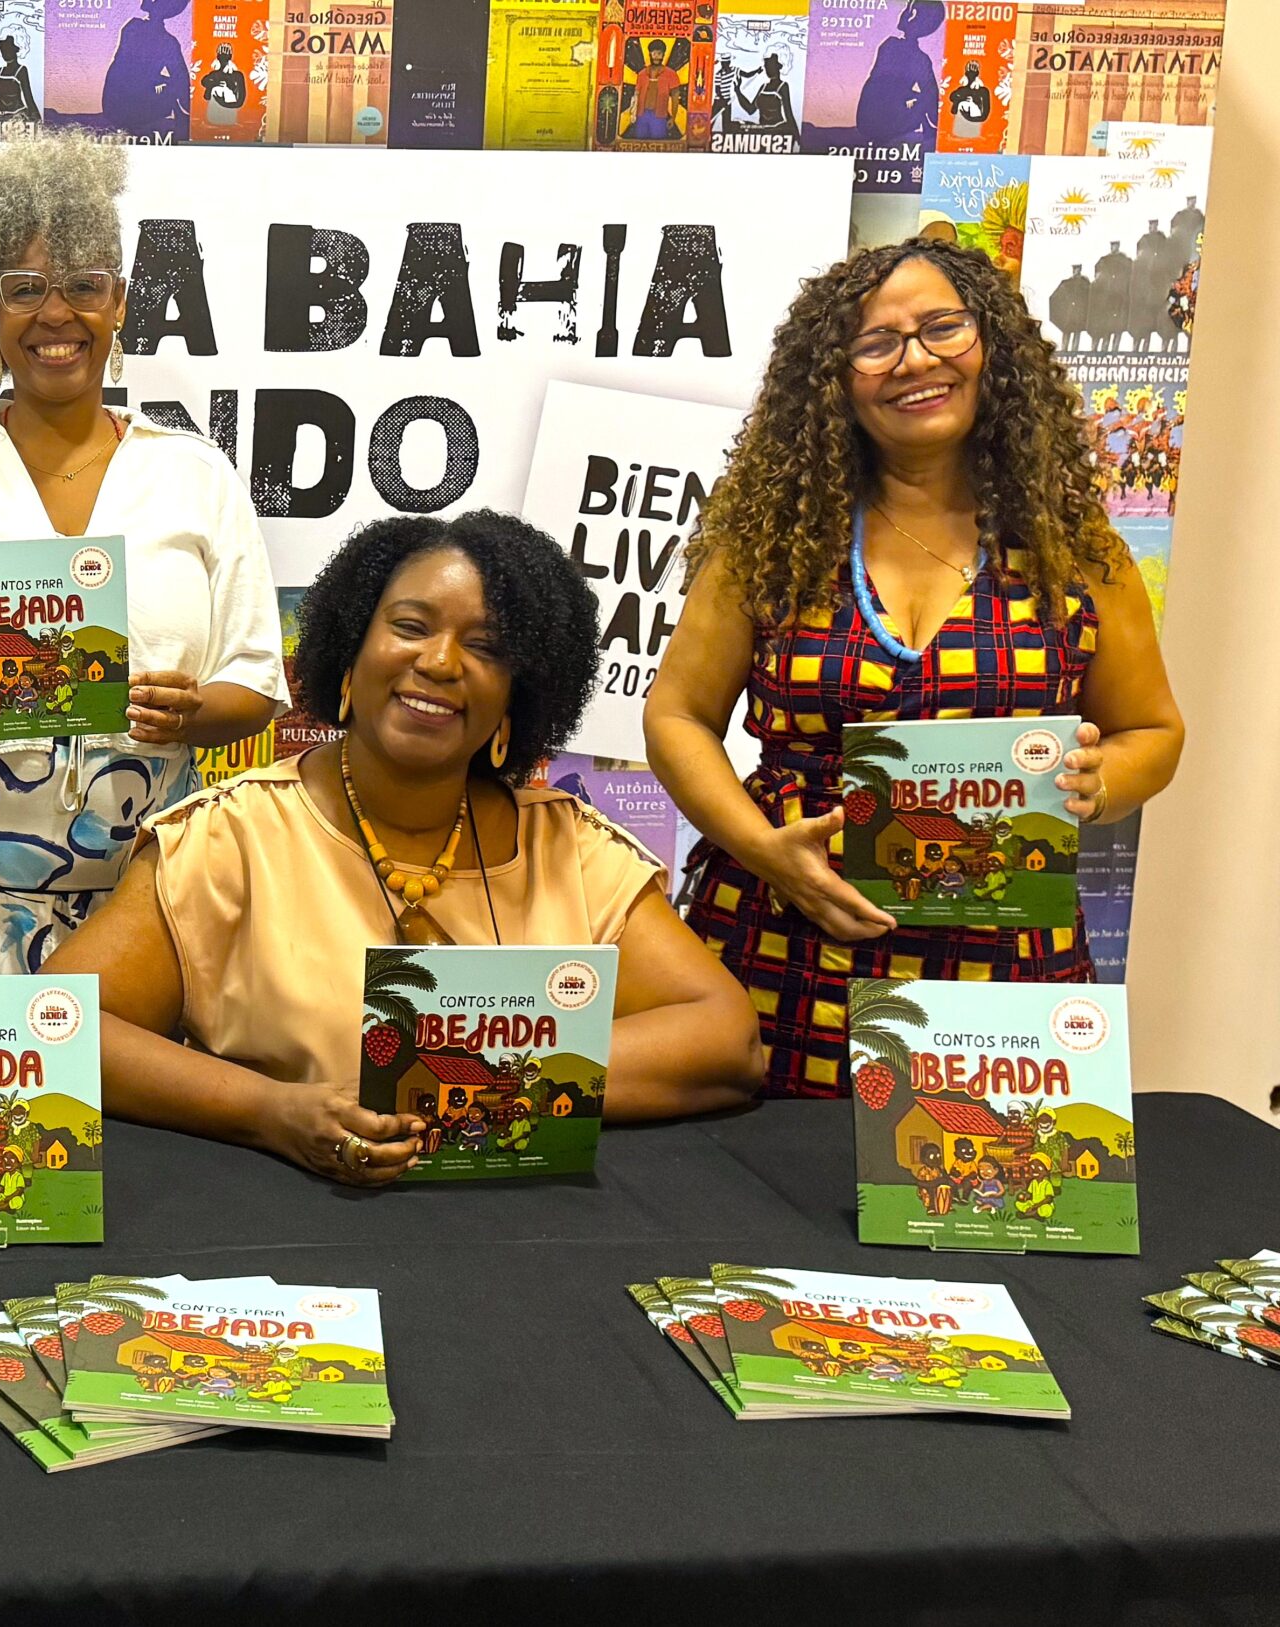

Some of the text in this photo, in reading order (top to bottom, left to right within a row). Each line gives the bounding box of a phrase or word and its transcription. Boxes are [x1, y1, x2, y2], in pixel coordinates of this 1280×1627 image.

[125, 219, 219, 357] A
[263, 222, 733, 358] BAHIA
[36, 578, 64, 590] PARA
[911, 761, 1002, 775] CONTOS PARA
[616, 798, 667, 812] Torres
[439, 995, 535, 1009] CONTOS PARA
[933, 1033, 1040, 1050] CONTOS PARA
[805, 1292, 868, 1305] CONTOS
[172, 1302, 238, 1315] CONTOS
